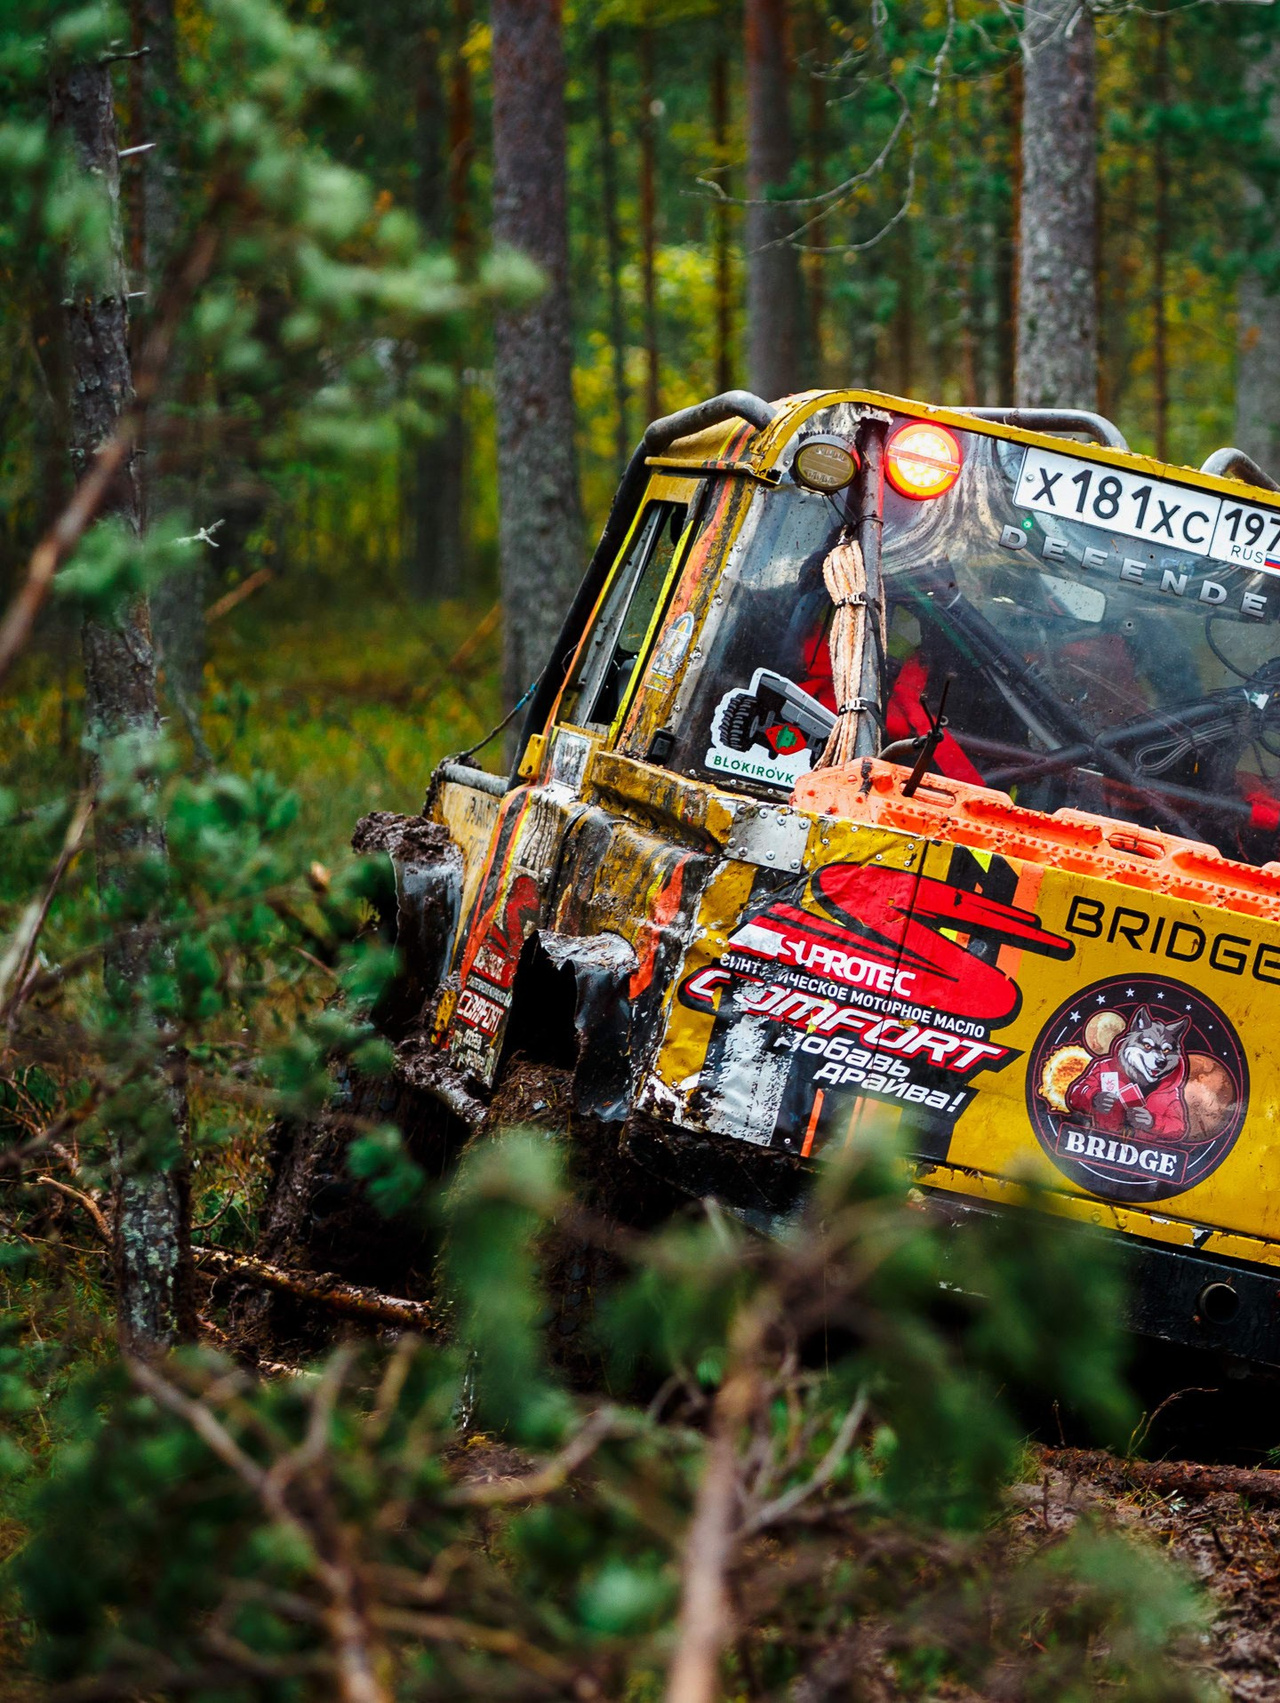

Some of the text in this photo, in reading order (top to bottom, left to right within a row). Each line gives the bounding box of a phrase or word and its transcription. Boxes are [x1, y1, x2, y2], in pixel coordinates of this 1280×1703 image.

[1230, 544, 1264, 565] RUS
[713, 755, 795, 784] BLOKIROVK
[780, 936, 916, 997] SUPROTEC
[719, 952, 985, 1039] СИНТИЧЕСКОЕ МОТОРНОЕ МАСЛО
[1065, 1130, 1178, 1177] BRIDGE
